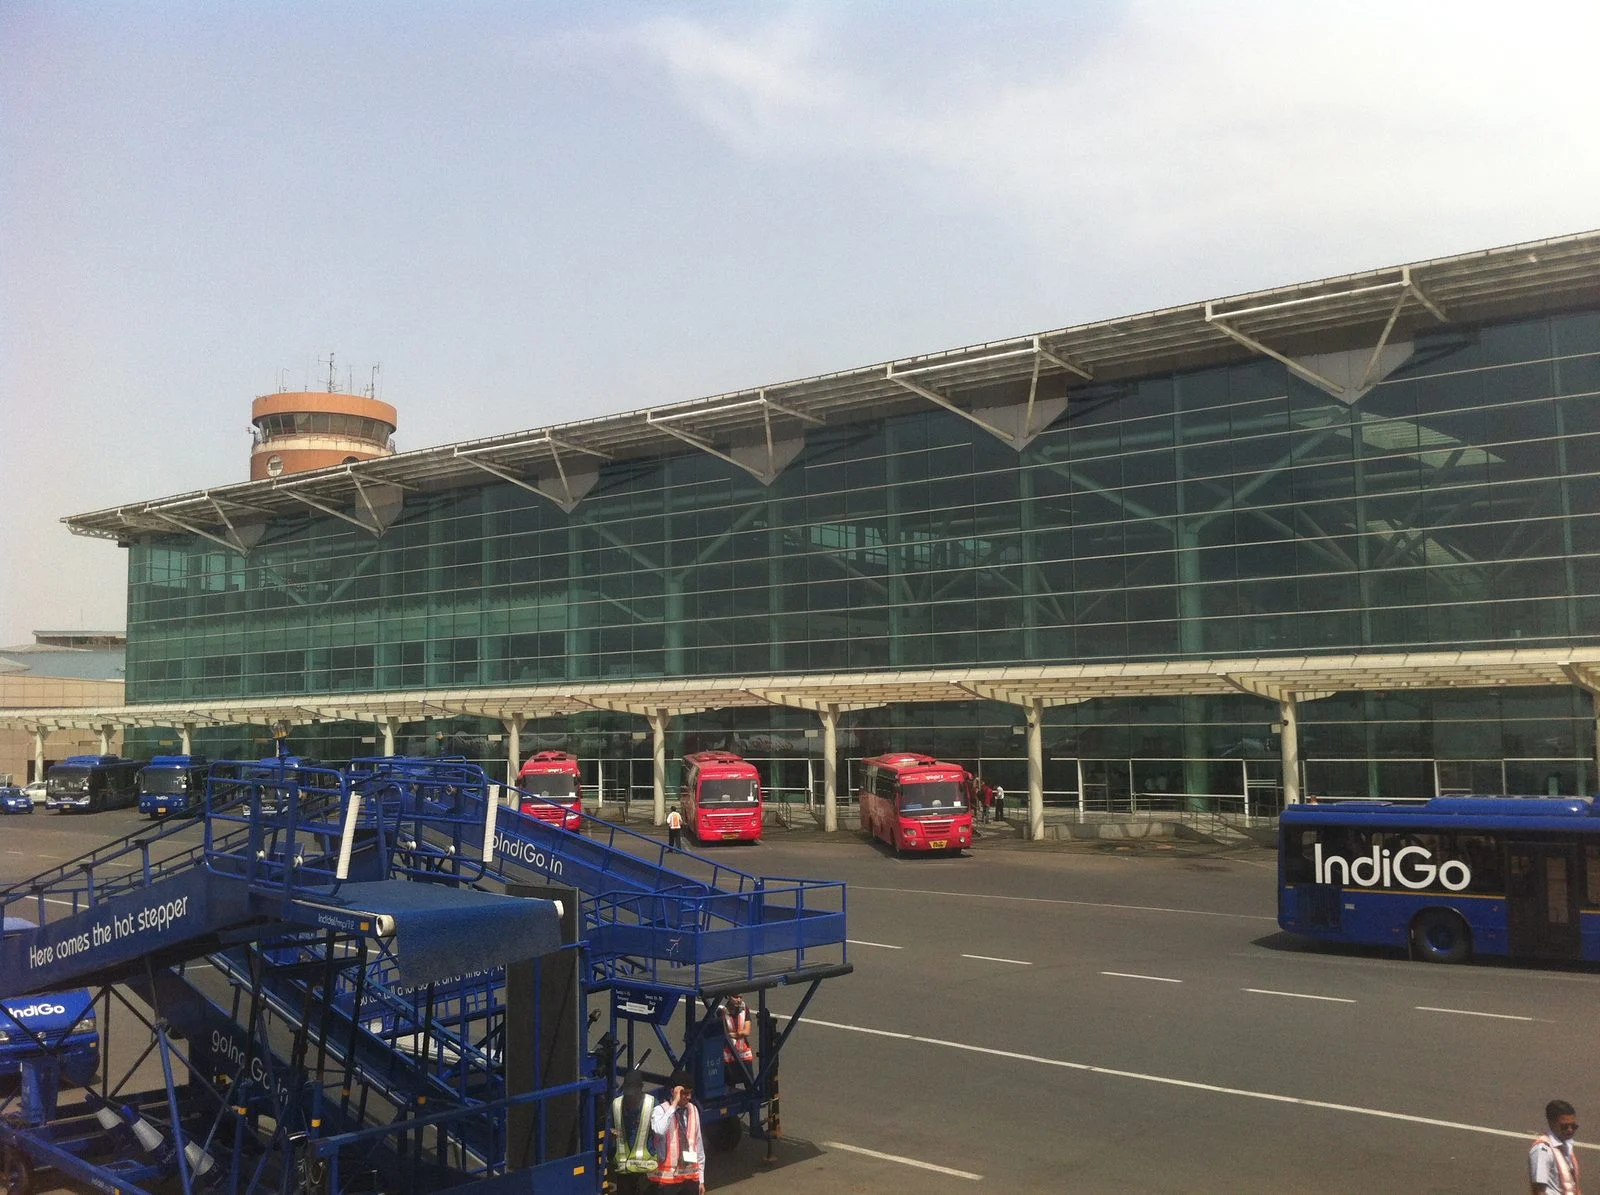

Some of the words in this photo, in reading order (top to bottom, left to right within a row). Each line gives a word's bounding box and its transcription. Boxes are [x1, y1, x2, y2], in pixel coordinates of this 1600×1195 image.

[1314, 843, 1471, 891] IndiGo
[29, 945, 54, 969] Here
[56, 932, 91, 959] comes
[92, 921, 112, 947] the
[114, 913, 135, 940] hot
[137, 895, 188, 932] stepper
[8, 1003, 66, 1019] IndiGo
